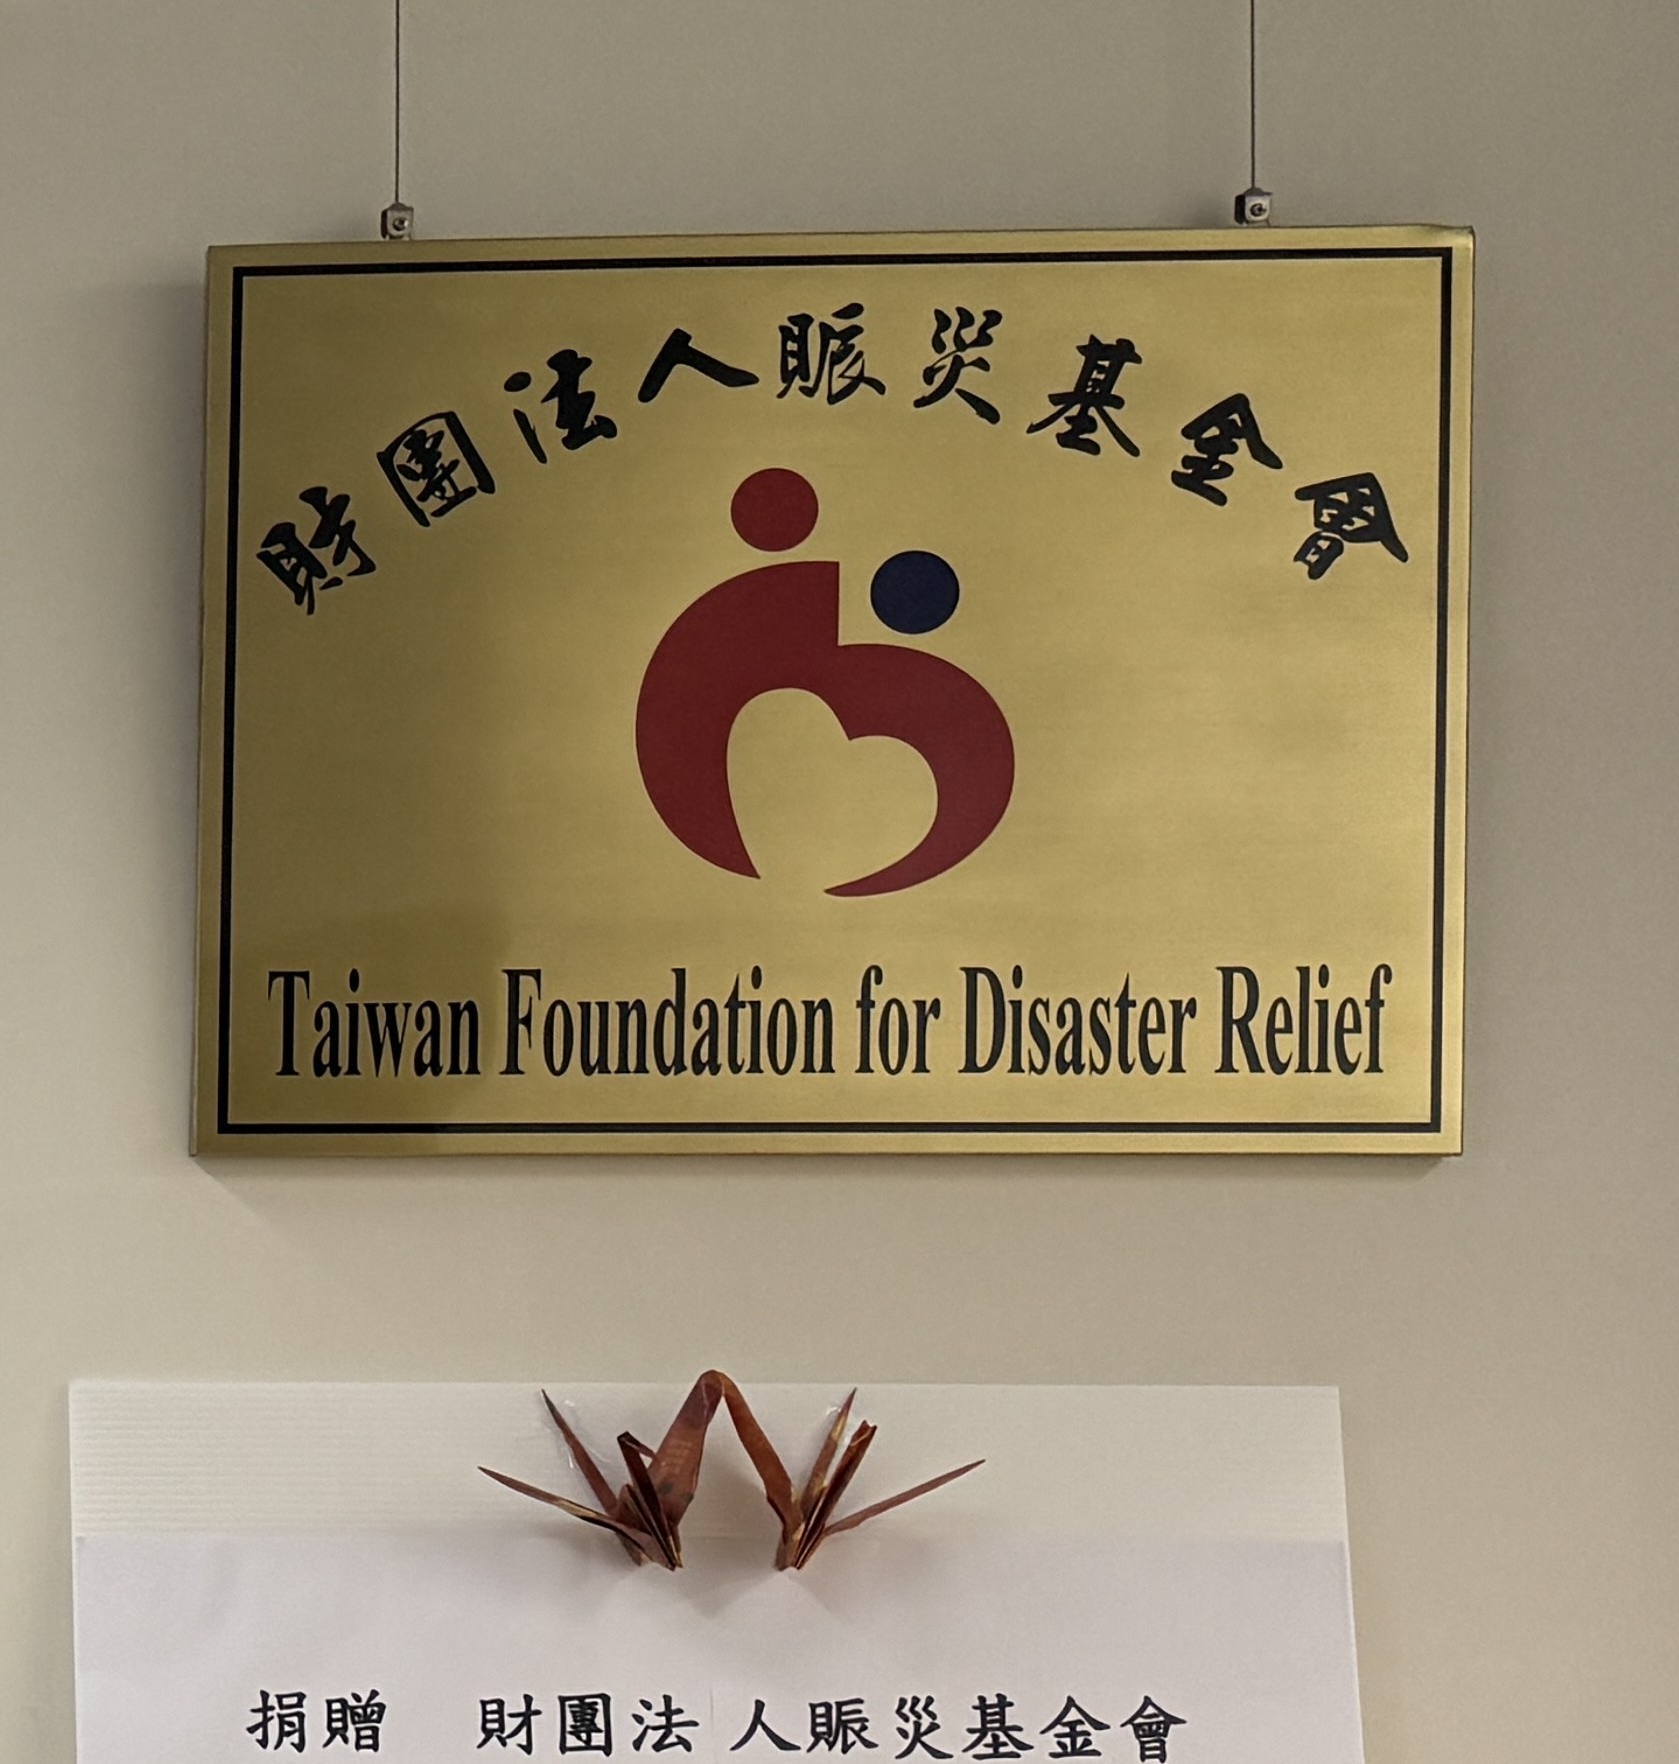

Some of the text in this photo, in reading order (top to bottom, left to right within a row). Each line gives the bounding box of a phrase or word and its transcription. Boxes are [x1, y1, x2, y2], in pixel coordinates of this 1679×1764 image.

[257, 302, 1410, 614] 財團法人賑災基金會
[268, 961, 1393, 1079] Taiwan Foundation for Disaster Relief
[246, 1688, 387, 1753] 捐贈
